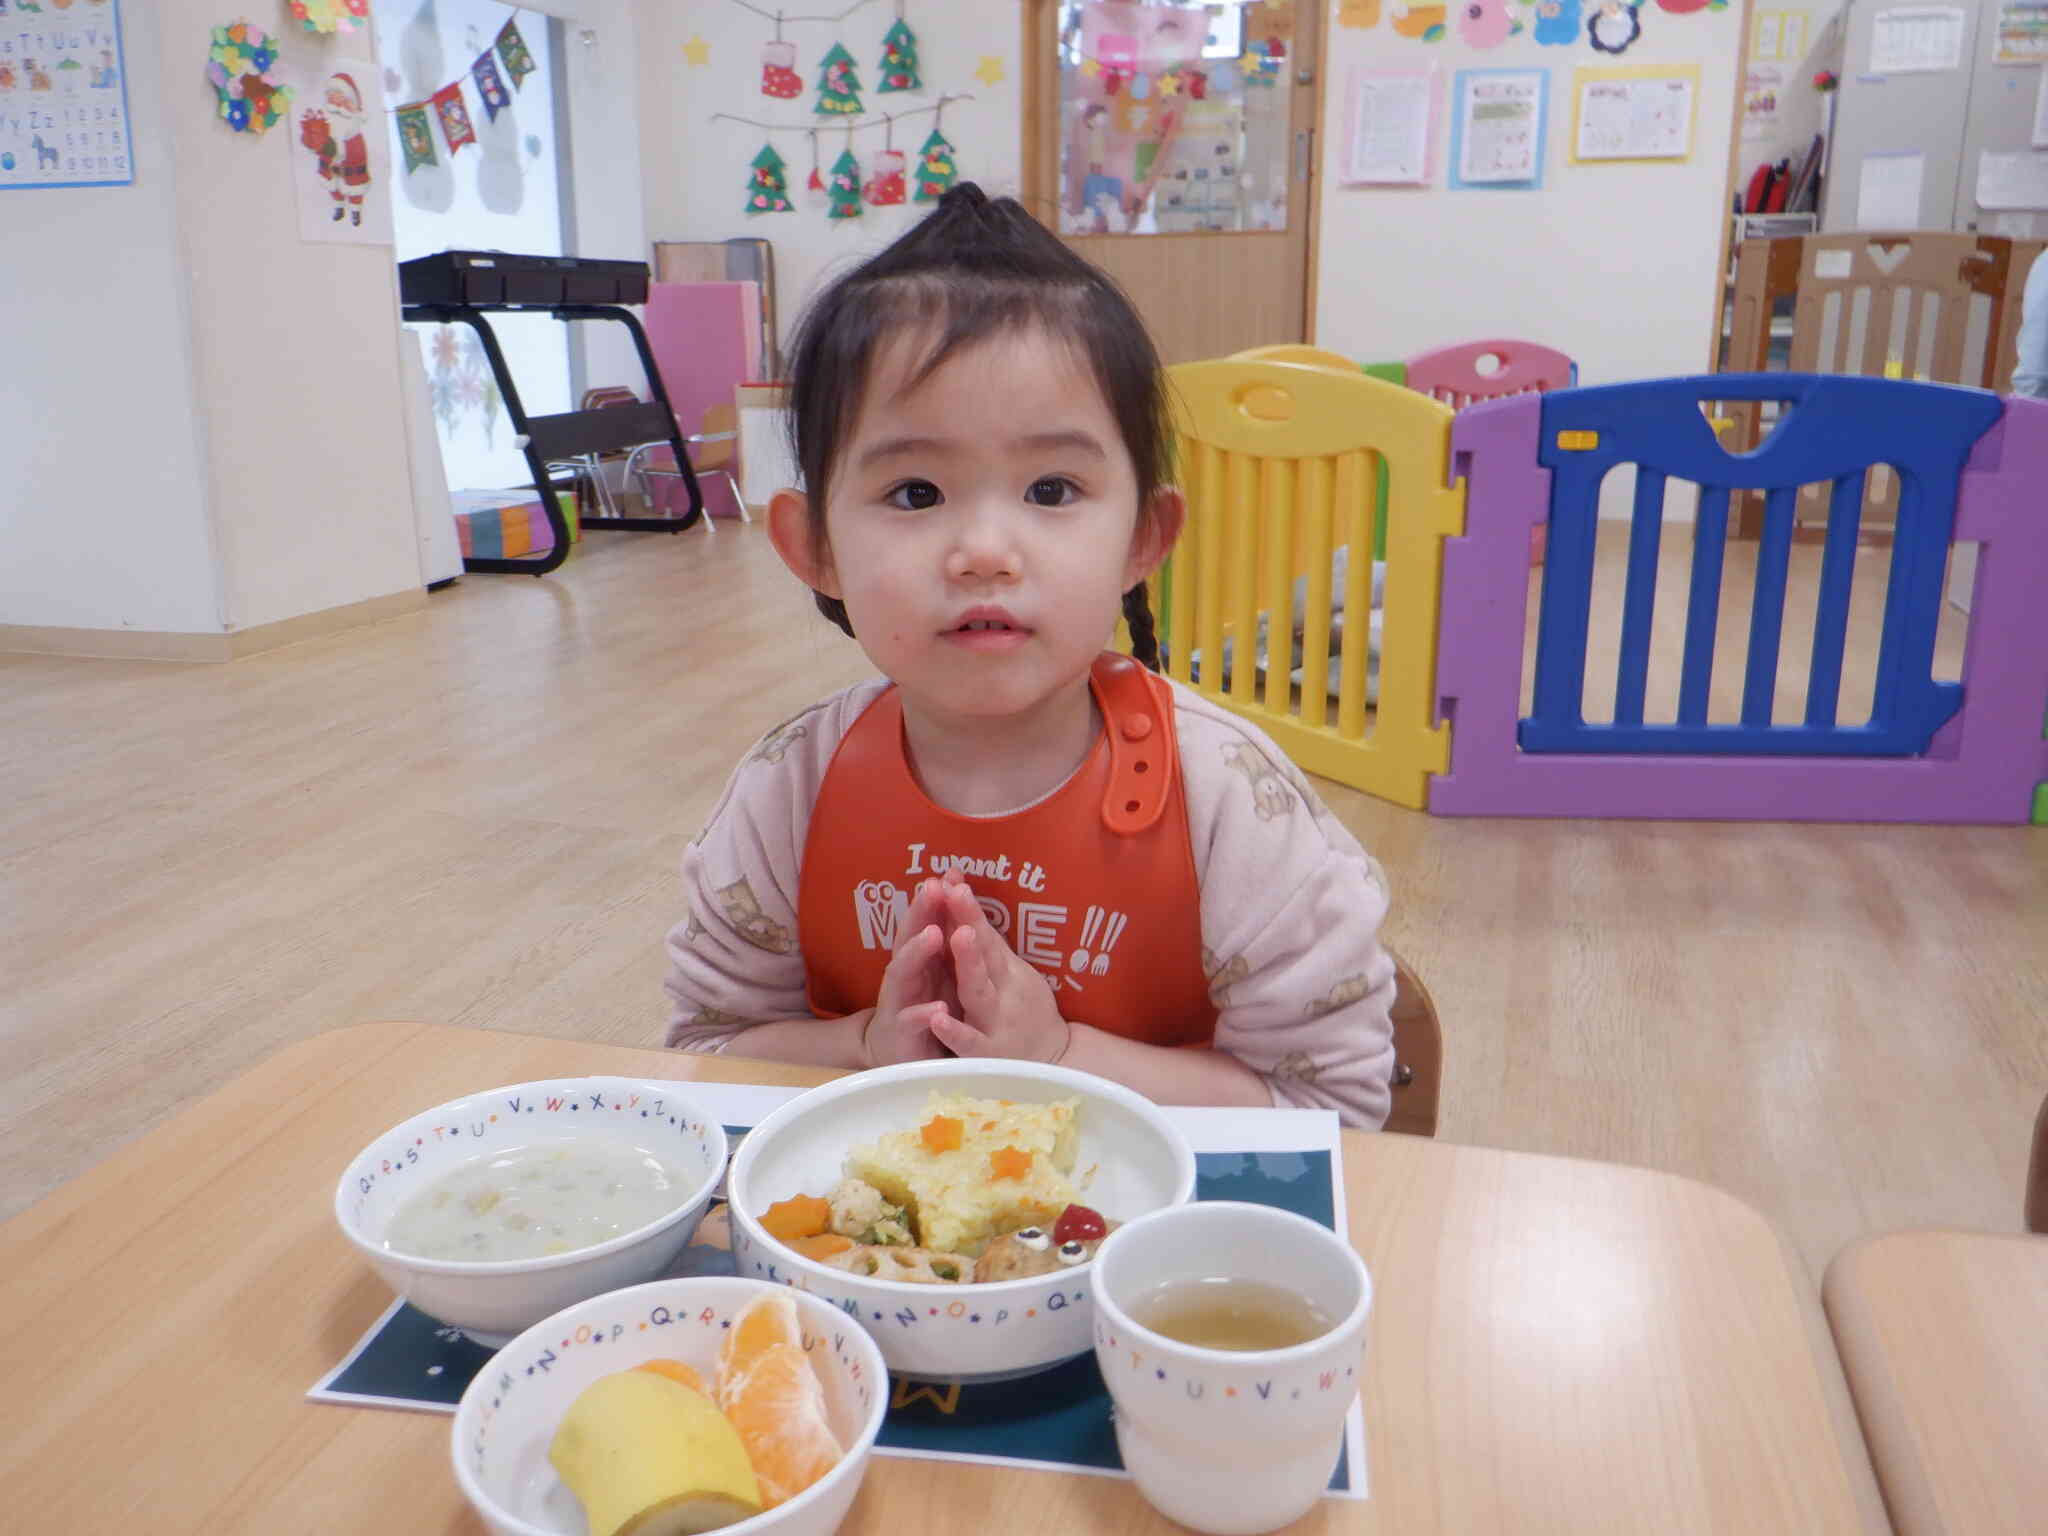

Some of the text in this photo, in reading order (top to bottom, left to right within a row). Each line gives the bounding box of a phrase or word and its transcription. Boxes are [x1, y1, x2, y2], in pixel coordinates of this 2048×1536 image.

[905, 842, 1047, 893] I want it
[471, 1121, 485, 1138] U
[508, 1097, 521, 1113] V
[546, 1096, 564, 1112] W
[590, 1093, 605, 1110] X
[654, 1100, 665, 1116] Z
[1048, 1292, 1069, 1311] Q
[612, 1324, 624, 1343] P
[651, 1306, 673, 1326] Q
[1255, 1380, 1272, 1400] V
